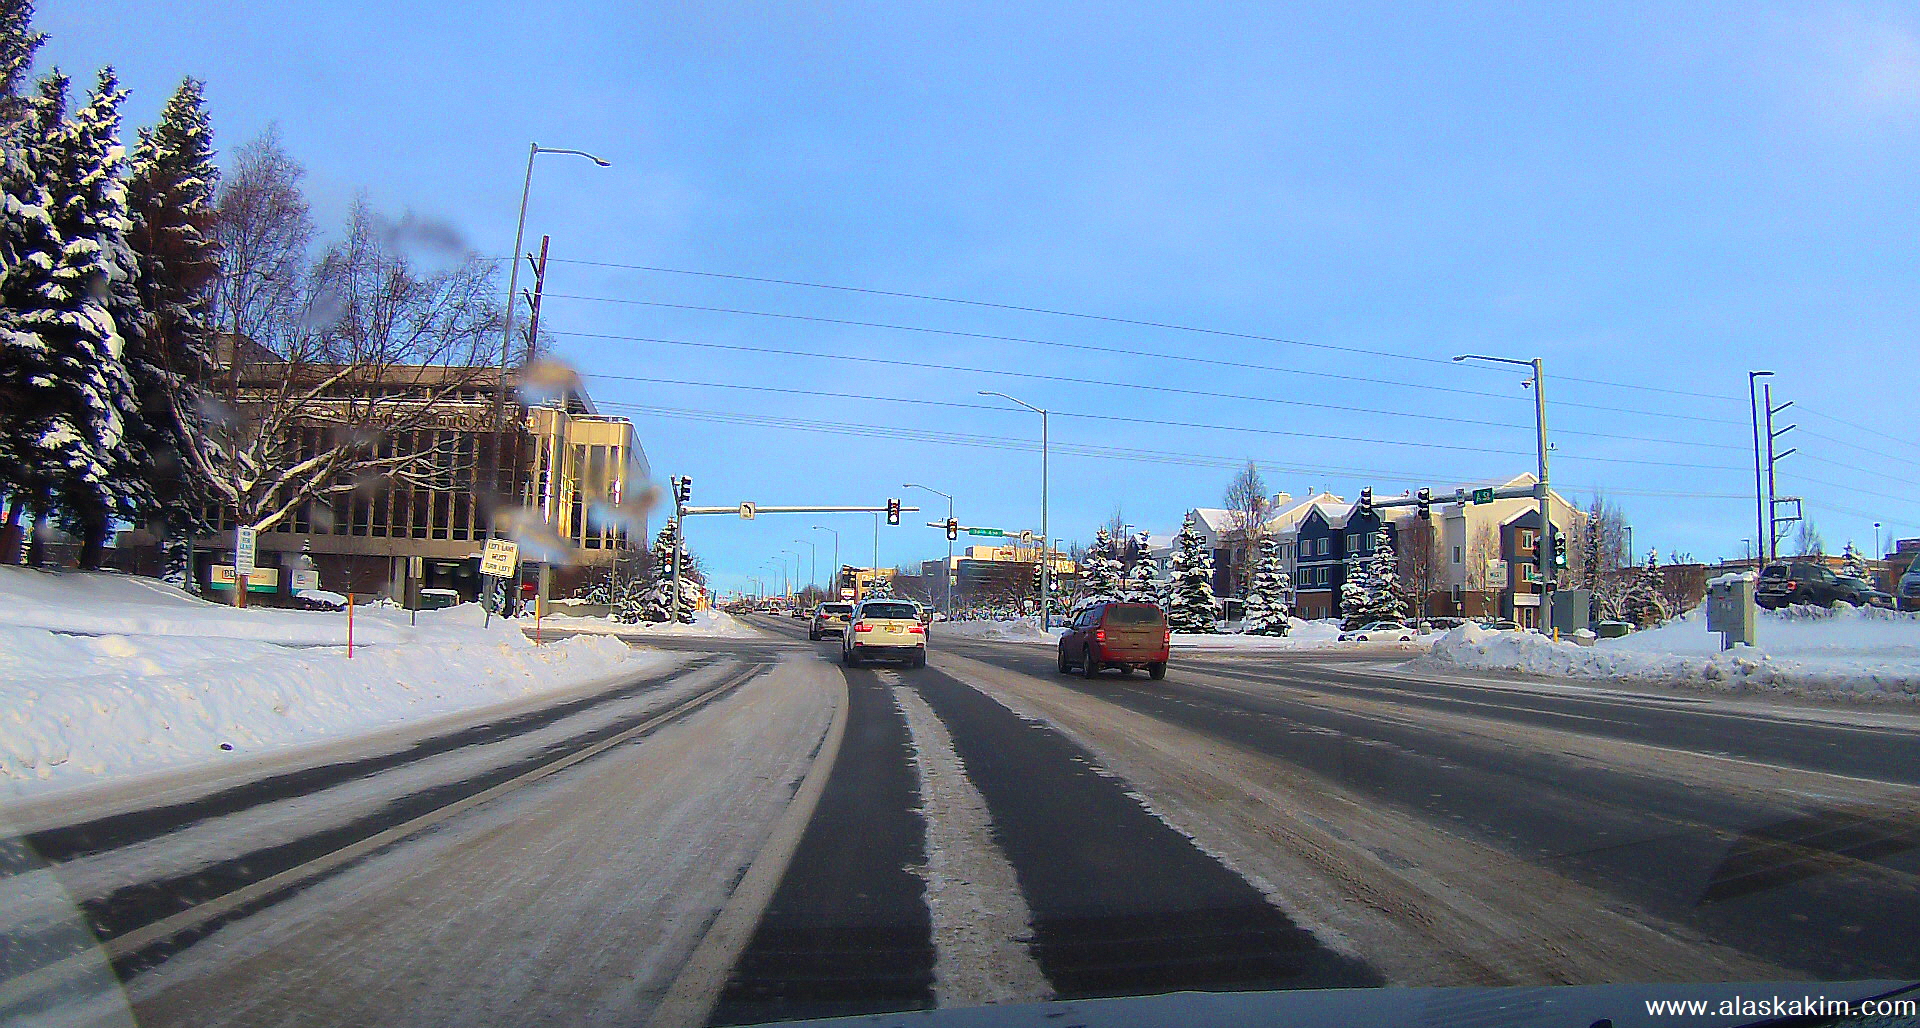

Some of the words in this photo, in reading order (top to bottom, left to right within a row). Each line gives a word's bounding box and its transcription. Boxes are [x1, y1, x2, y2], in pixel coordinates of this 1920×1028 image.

[488, 542, 500, 550] LEFT
[491, 553, 507, 561] MUST
[485, 562, 497, 570] TURN
